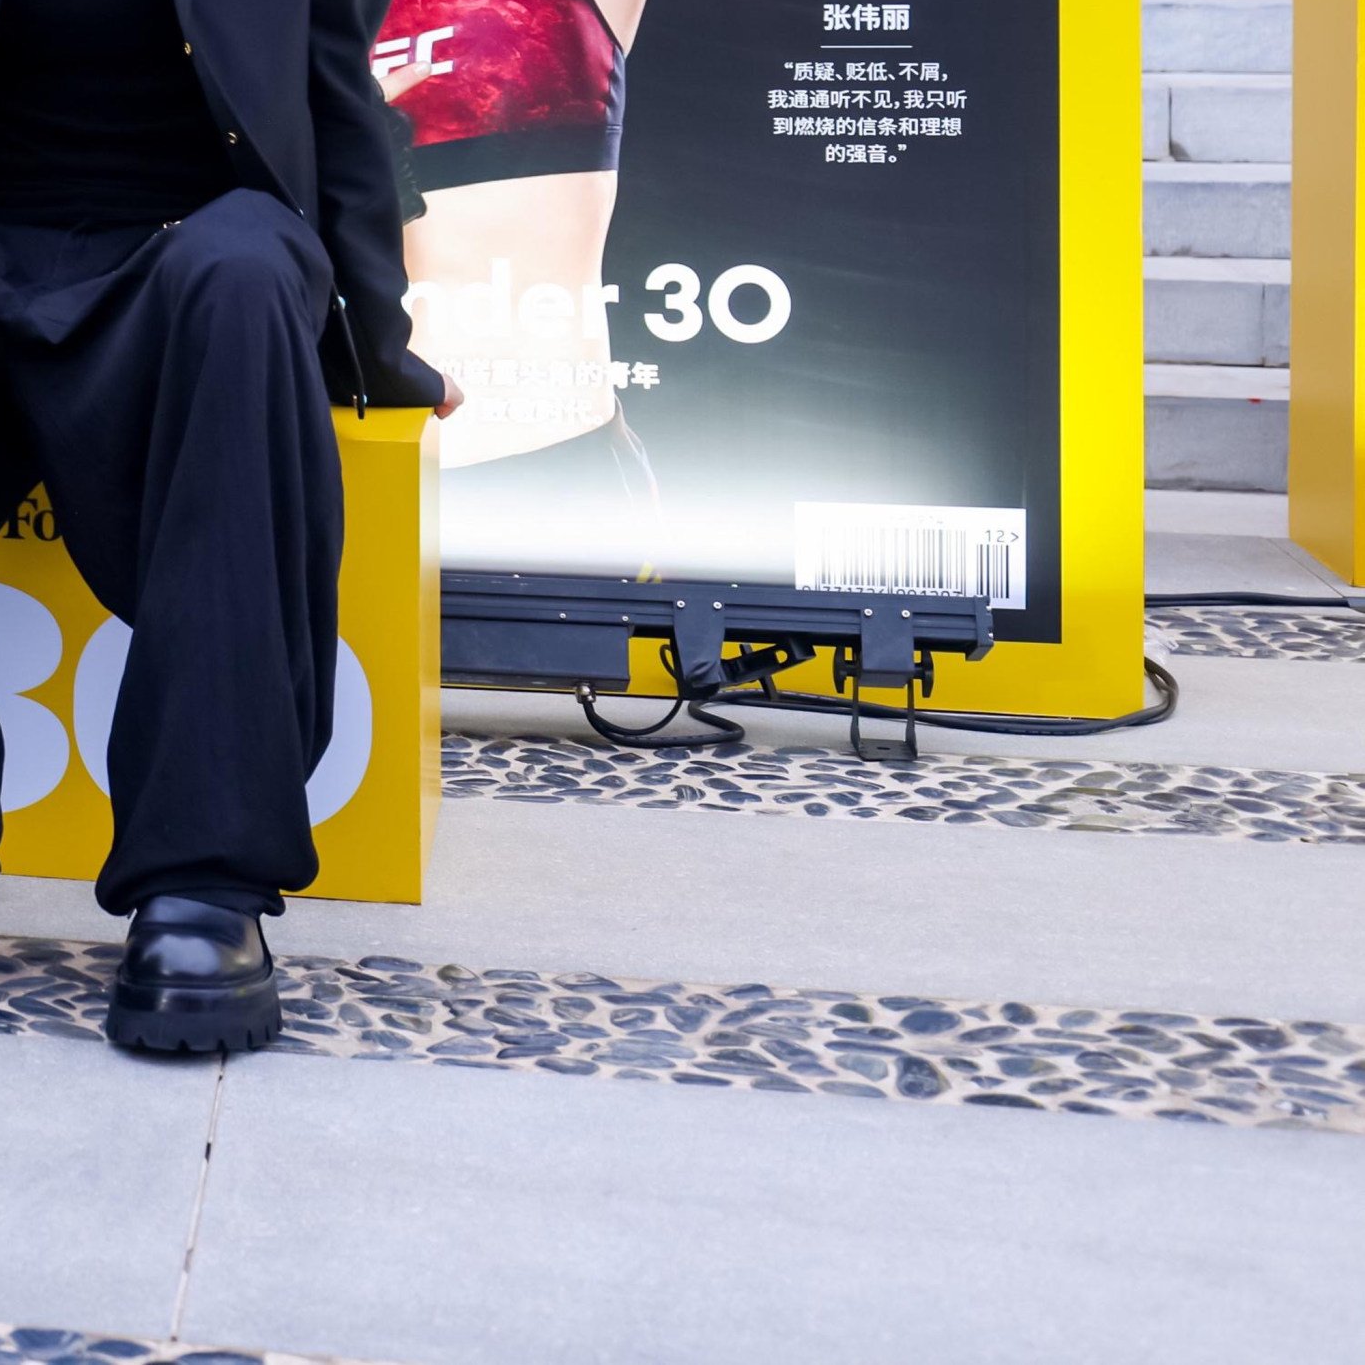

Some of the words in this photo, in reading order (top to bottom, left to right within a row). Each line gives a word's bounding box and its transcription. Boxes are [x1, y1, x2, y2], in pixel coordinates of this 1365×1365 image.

[823, 4, 911, 31] 张伟丽
[371, 25, 455, 81] FC
[773, 117, 963, 137] 到燃烧的信条和理想
[643, 262, 792, 344] 30
